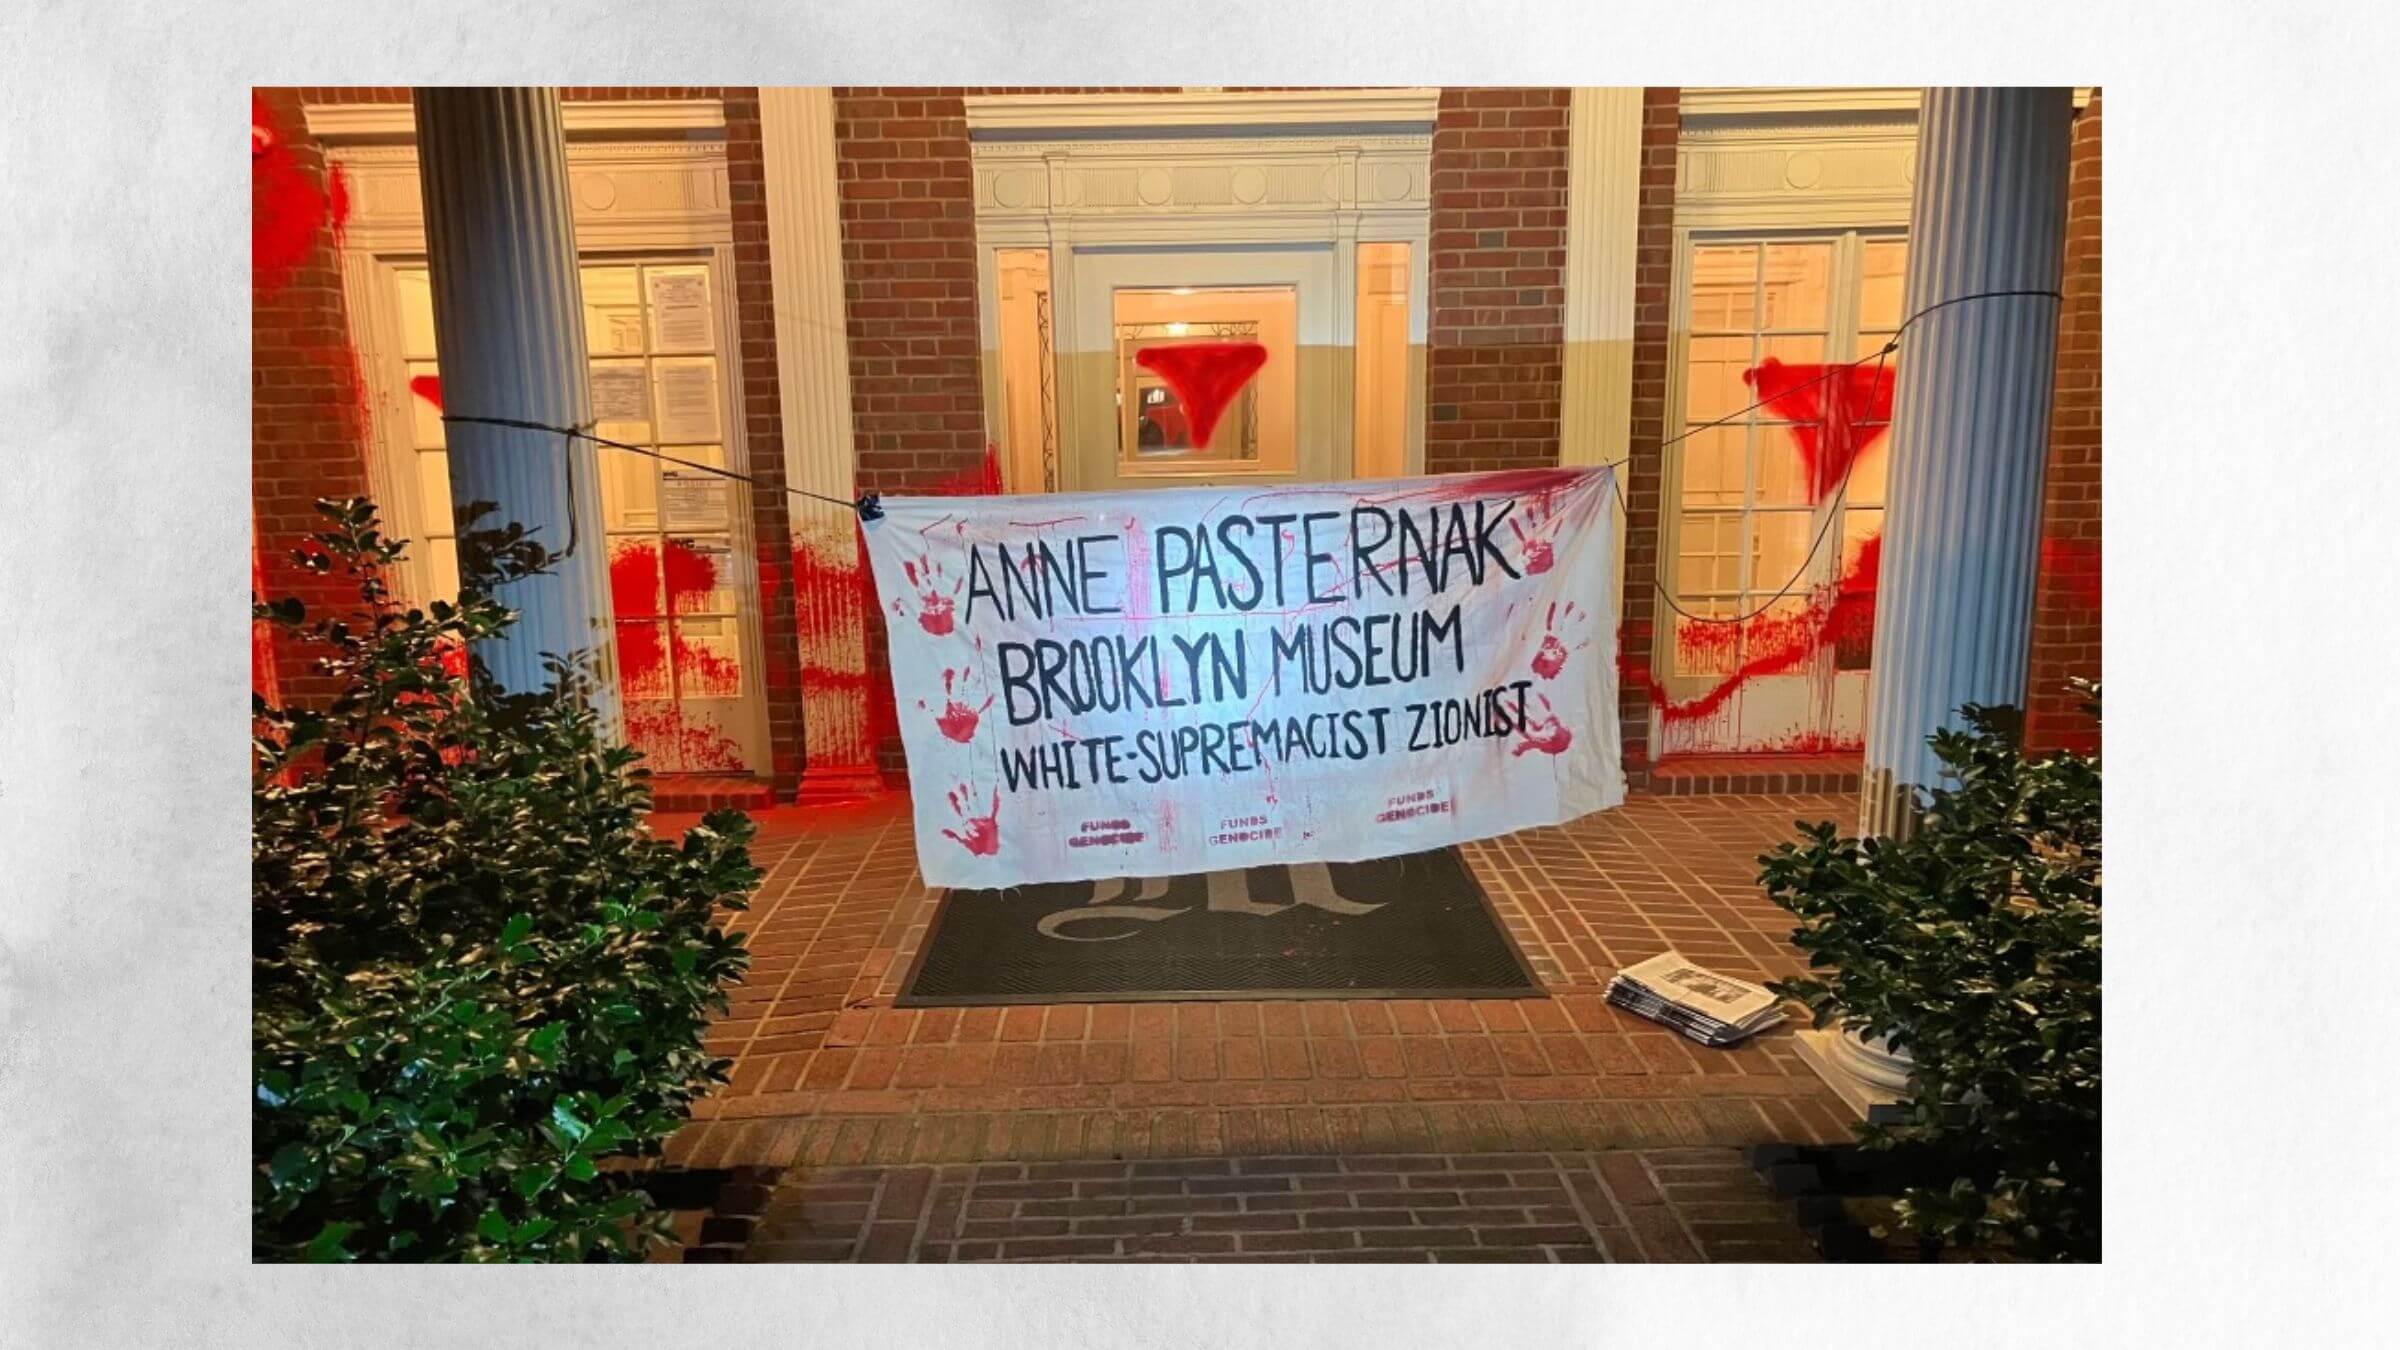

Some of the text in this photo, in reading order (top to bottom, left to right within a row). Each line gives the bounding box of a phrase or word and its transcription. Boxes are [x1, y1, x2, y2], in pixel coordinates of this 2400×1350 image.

[965, 500, 1521, 624] ANNE PASTERNAK
[997, 605, 1465, 726] BROOKLYN MUSEUM
[1000, 680, 1533, 792] WHITE-SUPREMACIST ZIONIST
[1388, 790, 1434, 807] FUNDS
[1220, 815, 1268, 830] FUNDS
[1376, 801, 1449, 823] GENOCIDE
[1208, 827, 1282, 846] GENOCIDE
